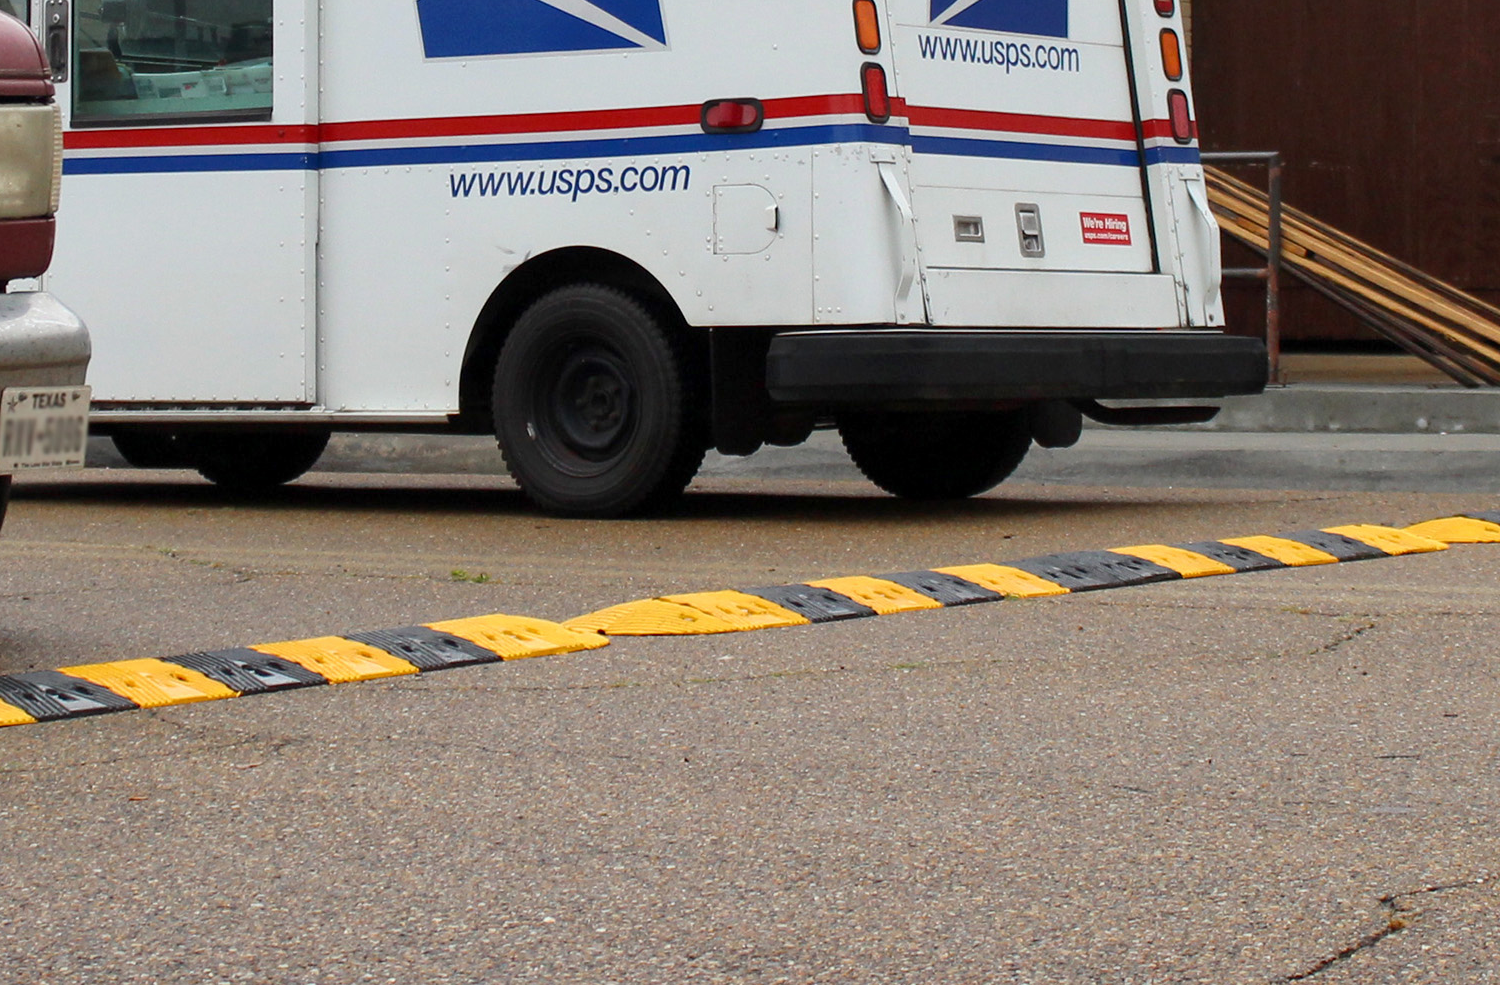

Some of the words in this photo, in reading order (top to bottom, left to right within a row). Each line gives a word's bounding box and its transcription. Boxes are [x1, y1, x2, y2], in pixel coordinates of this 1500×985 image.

[918, 34, 1080, 74] www.usps.com
[450, 165, 691, 202] www.usps.com
[1083, 217, 1104, 229] We're
[1105, 218, 1127, 232] Hiring
[32, 393, 67, 409] TEXAS
